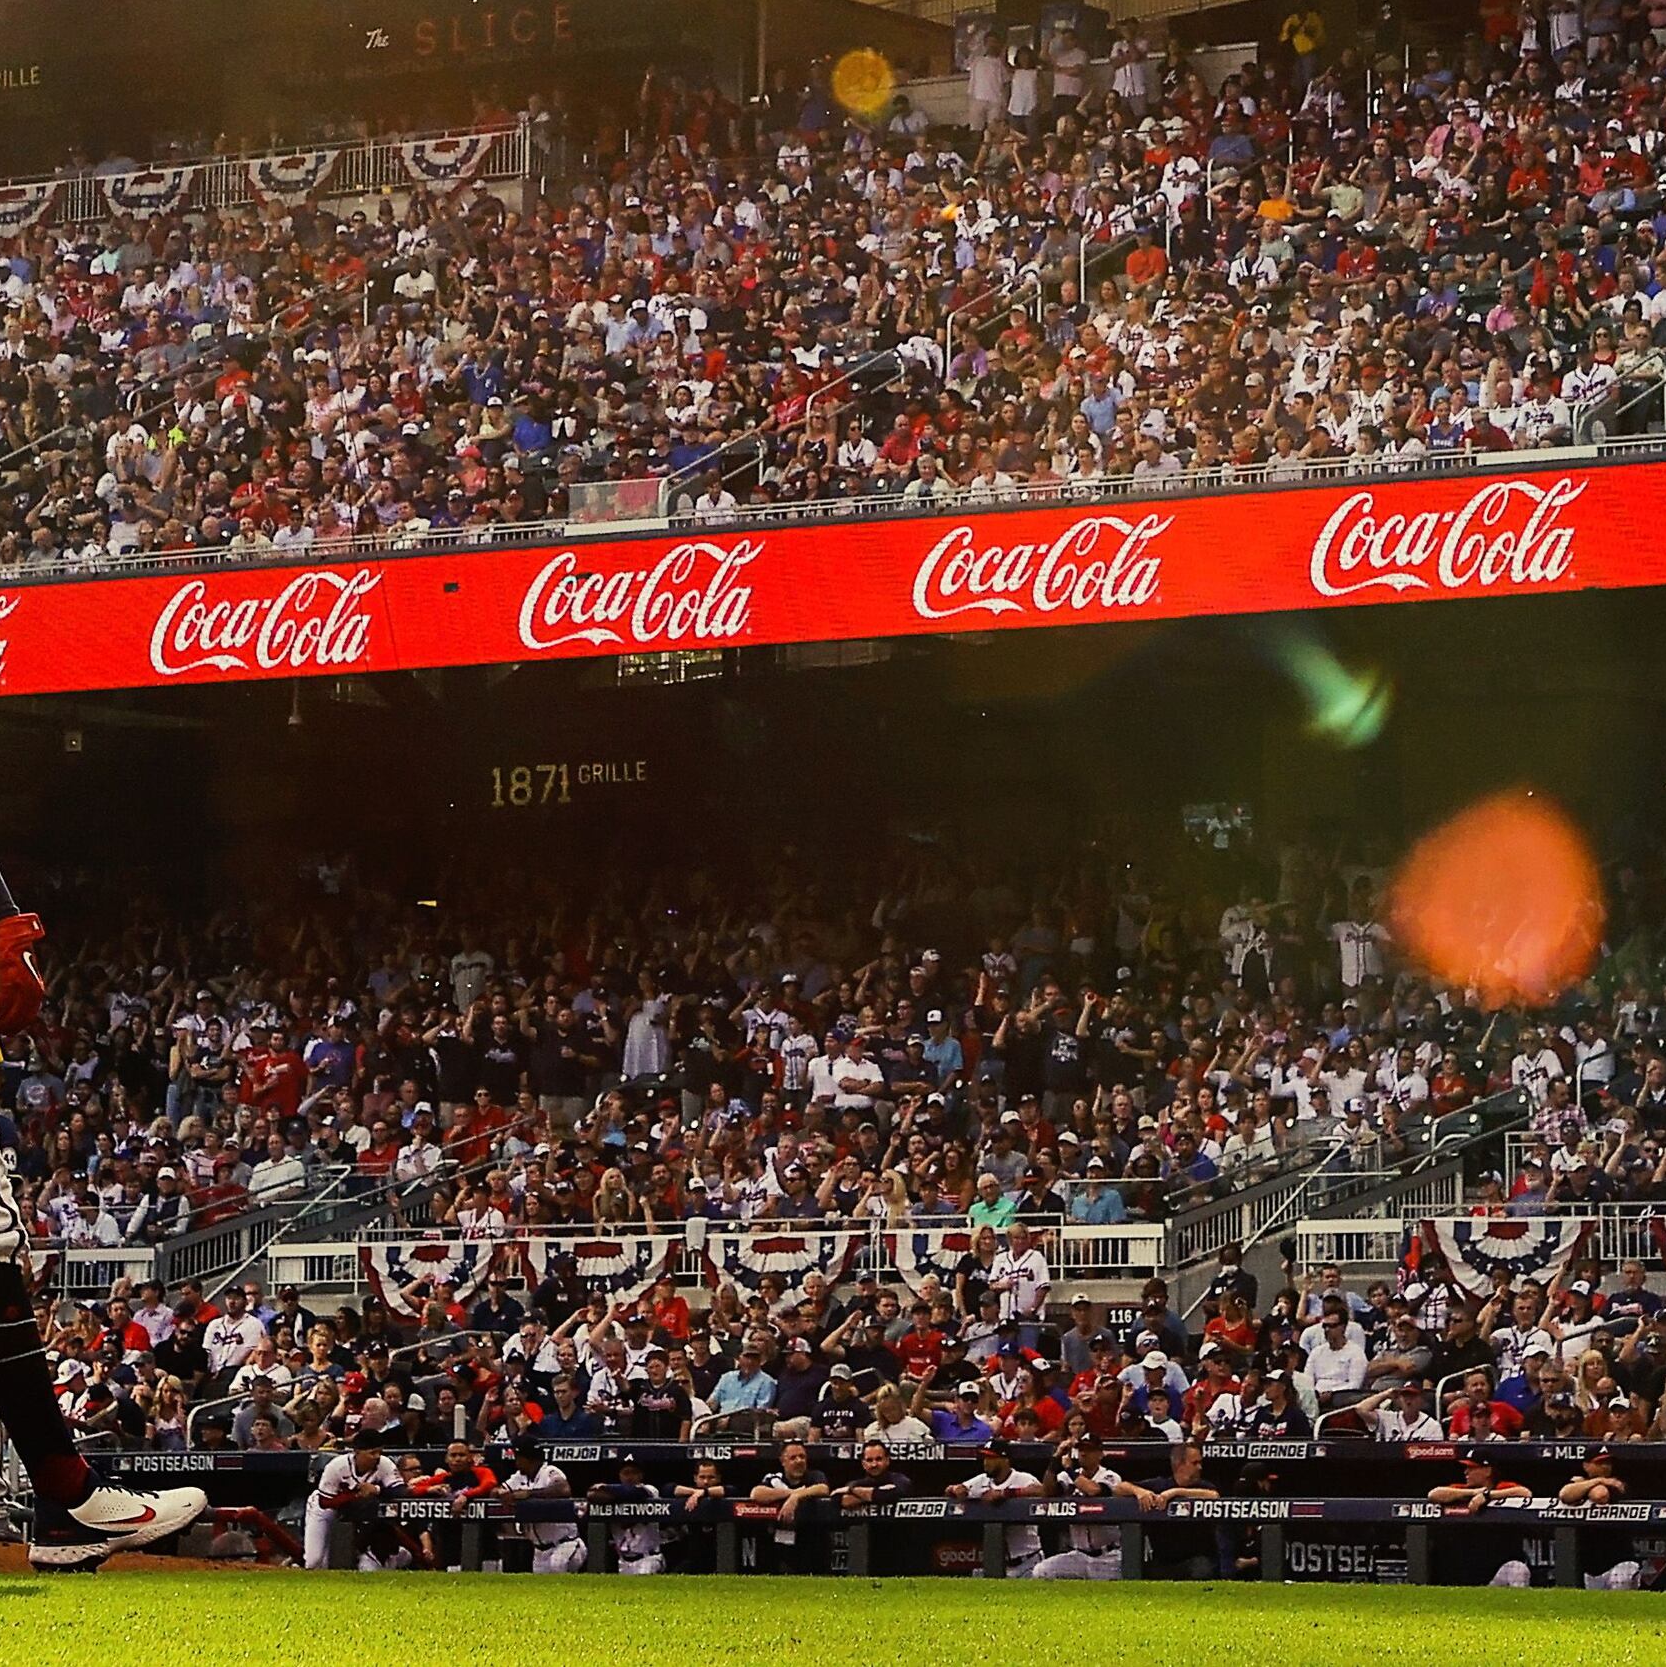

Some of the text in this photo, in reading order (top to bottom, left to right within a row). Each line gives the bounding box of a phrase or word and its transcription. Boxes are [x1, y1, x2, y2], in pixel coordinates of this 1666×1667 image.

[366, 5, 576, 55] The SLICE
[490, 761, 647, 808] 1871 GRILLE
[1109, 1309, 1133, 1324] 116
[554, 1446, 600, 1461] MAJOR
[704, 1447, 732, 1460] NLDS
[1250, 1444, 1306, 1458] GRANDE
[134, 1454, 215, 1472] POSTSEASON
[589, 1503, 671, 1517] MLB NETWORK
[880, 1502, 893, 1517] IT
[896, 1502, 945, 1518] MAJOR
[1047, 1502, 1077, 1517] NLDS
[1193, 1500, 1290, 1519] POSTSEASON
[1410, 1504, 1442, 1518] NLDS
[1587, 1505, 1649, 1520] GRANDE
